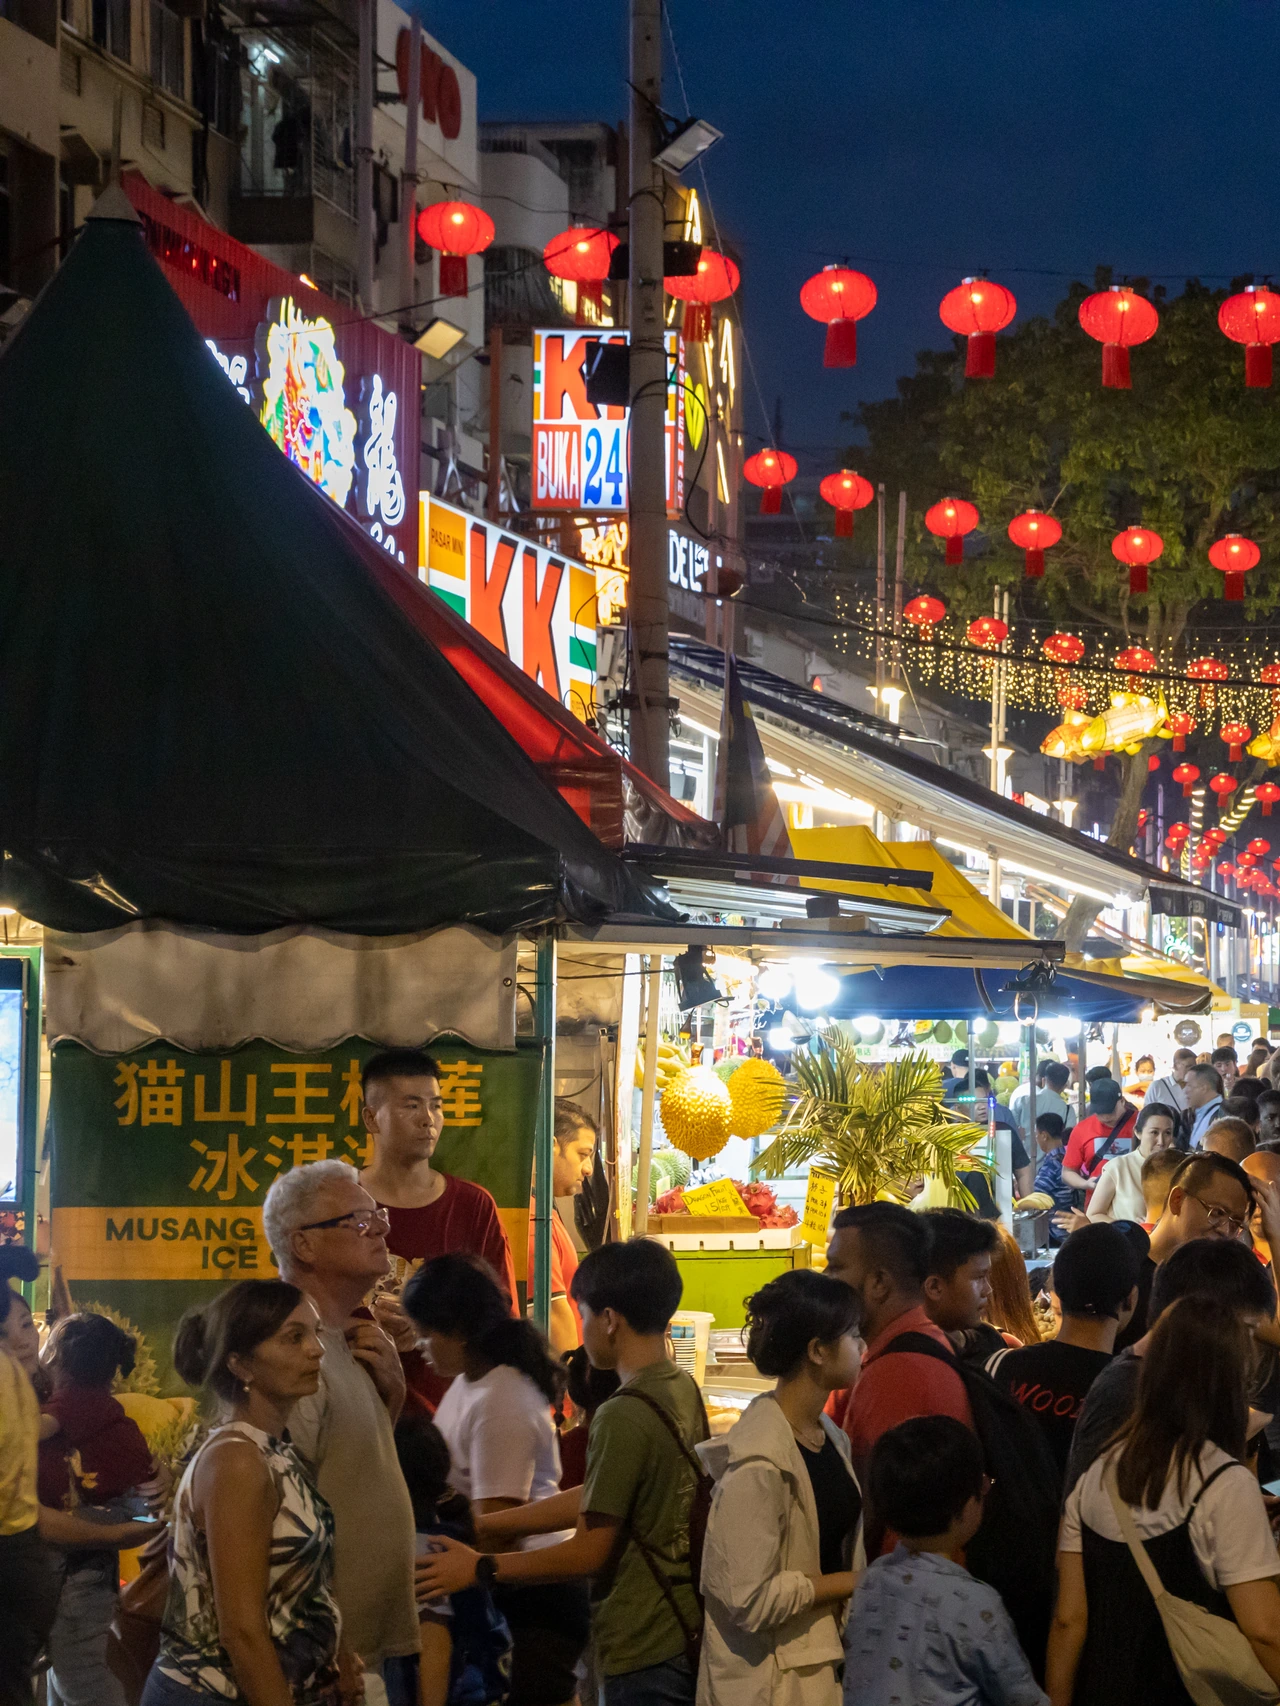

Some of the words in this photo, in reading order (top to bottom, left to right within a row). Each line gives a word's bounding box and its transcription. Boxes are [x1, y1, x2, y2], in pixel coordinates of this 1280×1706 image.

[676, 369, 685, 508] SUPERMART
[537, 430, 579, 499] BUKA
[584, 427, 624, 505] 24
[430, 527, 450, 551] PASAR
[451, 537, 464, 557] MINI
[470, 521, 567, 701] KK
[106, 1216, 256, 1242] MUSANG
[202, 1245, 259, 1270] ICE
